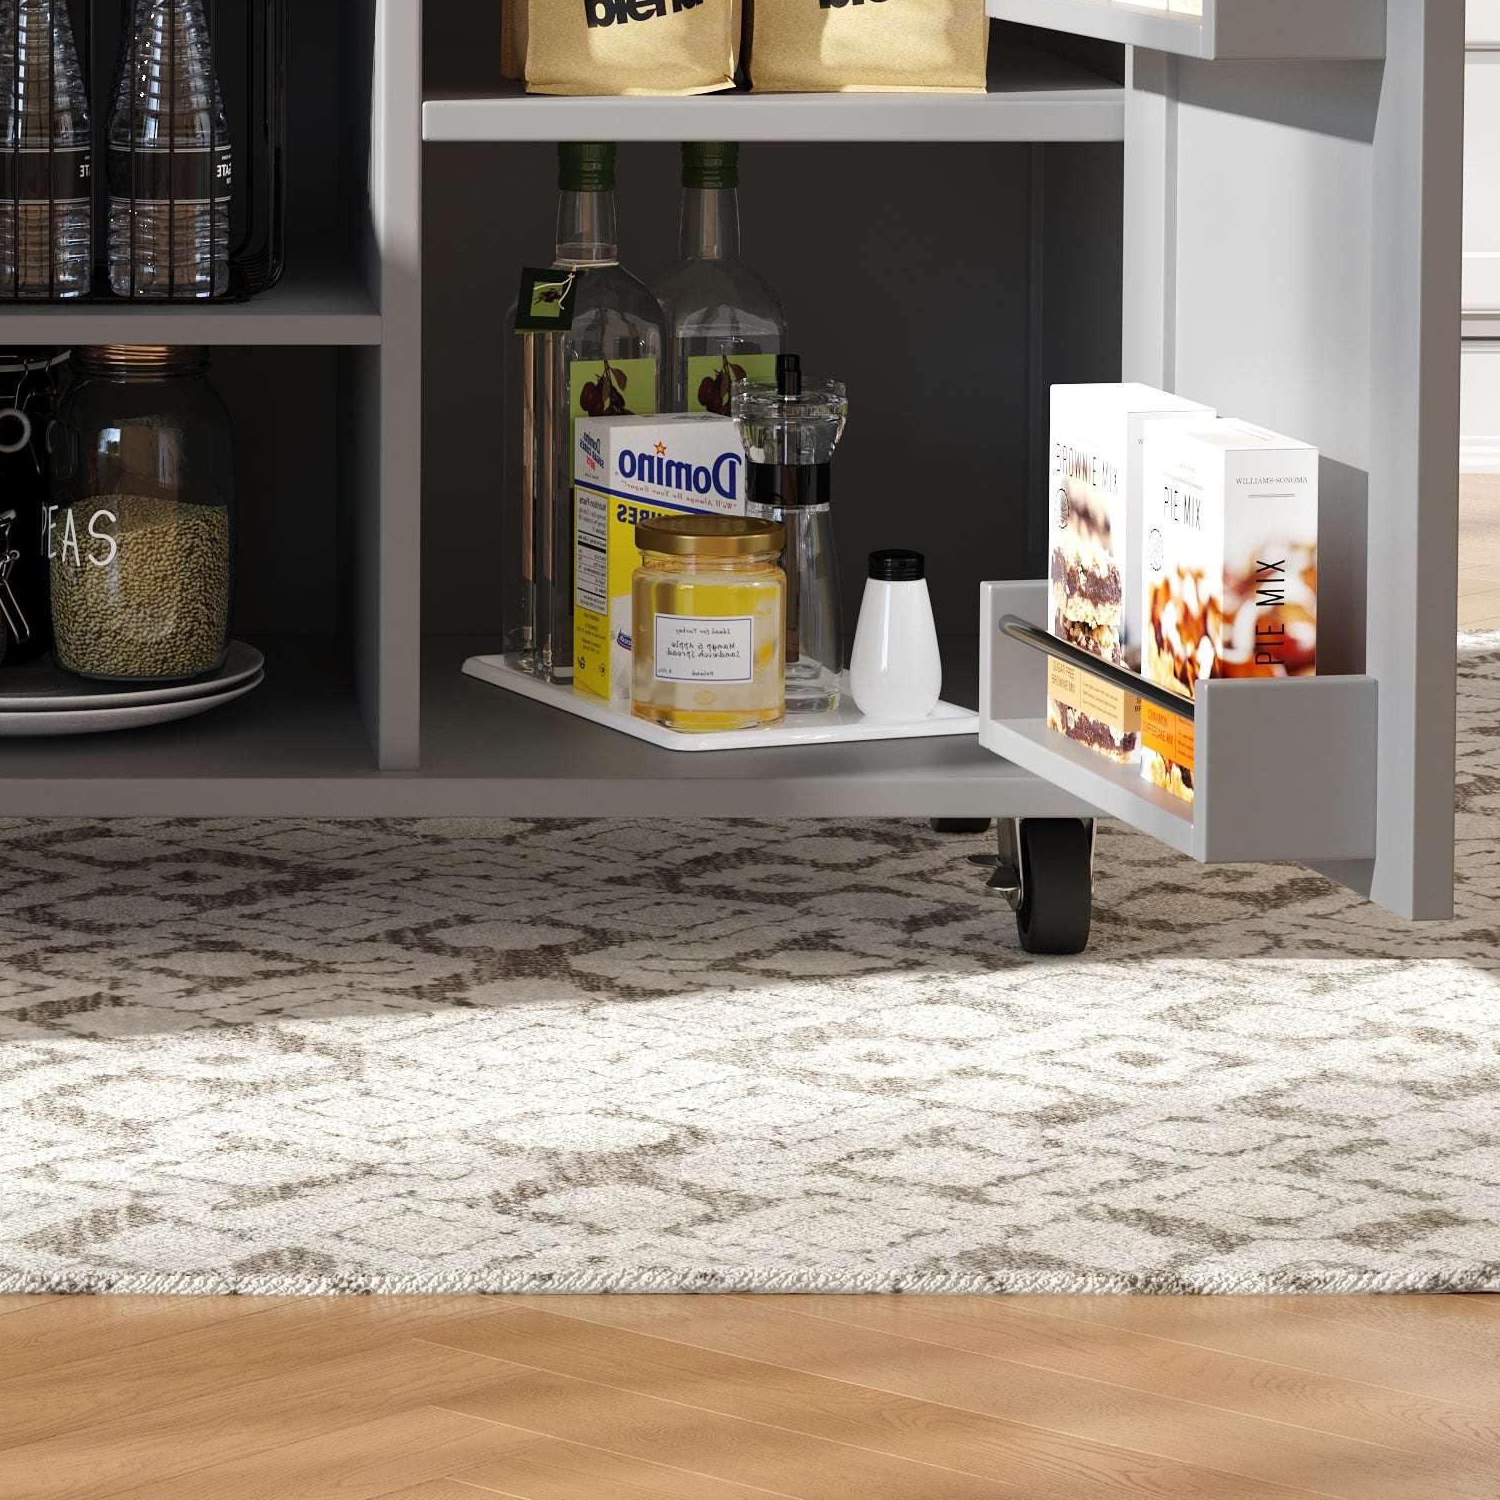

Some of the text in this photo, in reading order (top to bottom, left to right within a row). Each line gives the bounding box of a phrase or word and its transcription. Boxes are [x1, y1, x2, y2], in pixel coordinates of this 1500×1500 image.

[1056, 443, 1118, 493] BROWNIE MIX
[40, 504, 118, 568] PEAS
[1164, 487, 1201, 531] PIE MIX
[1254, 558, 1286, 666] PIE MIX
